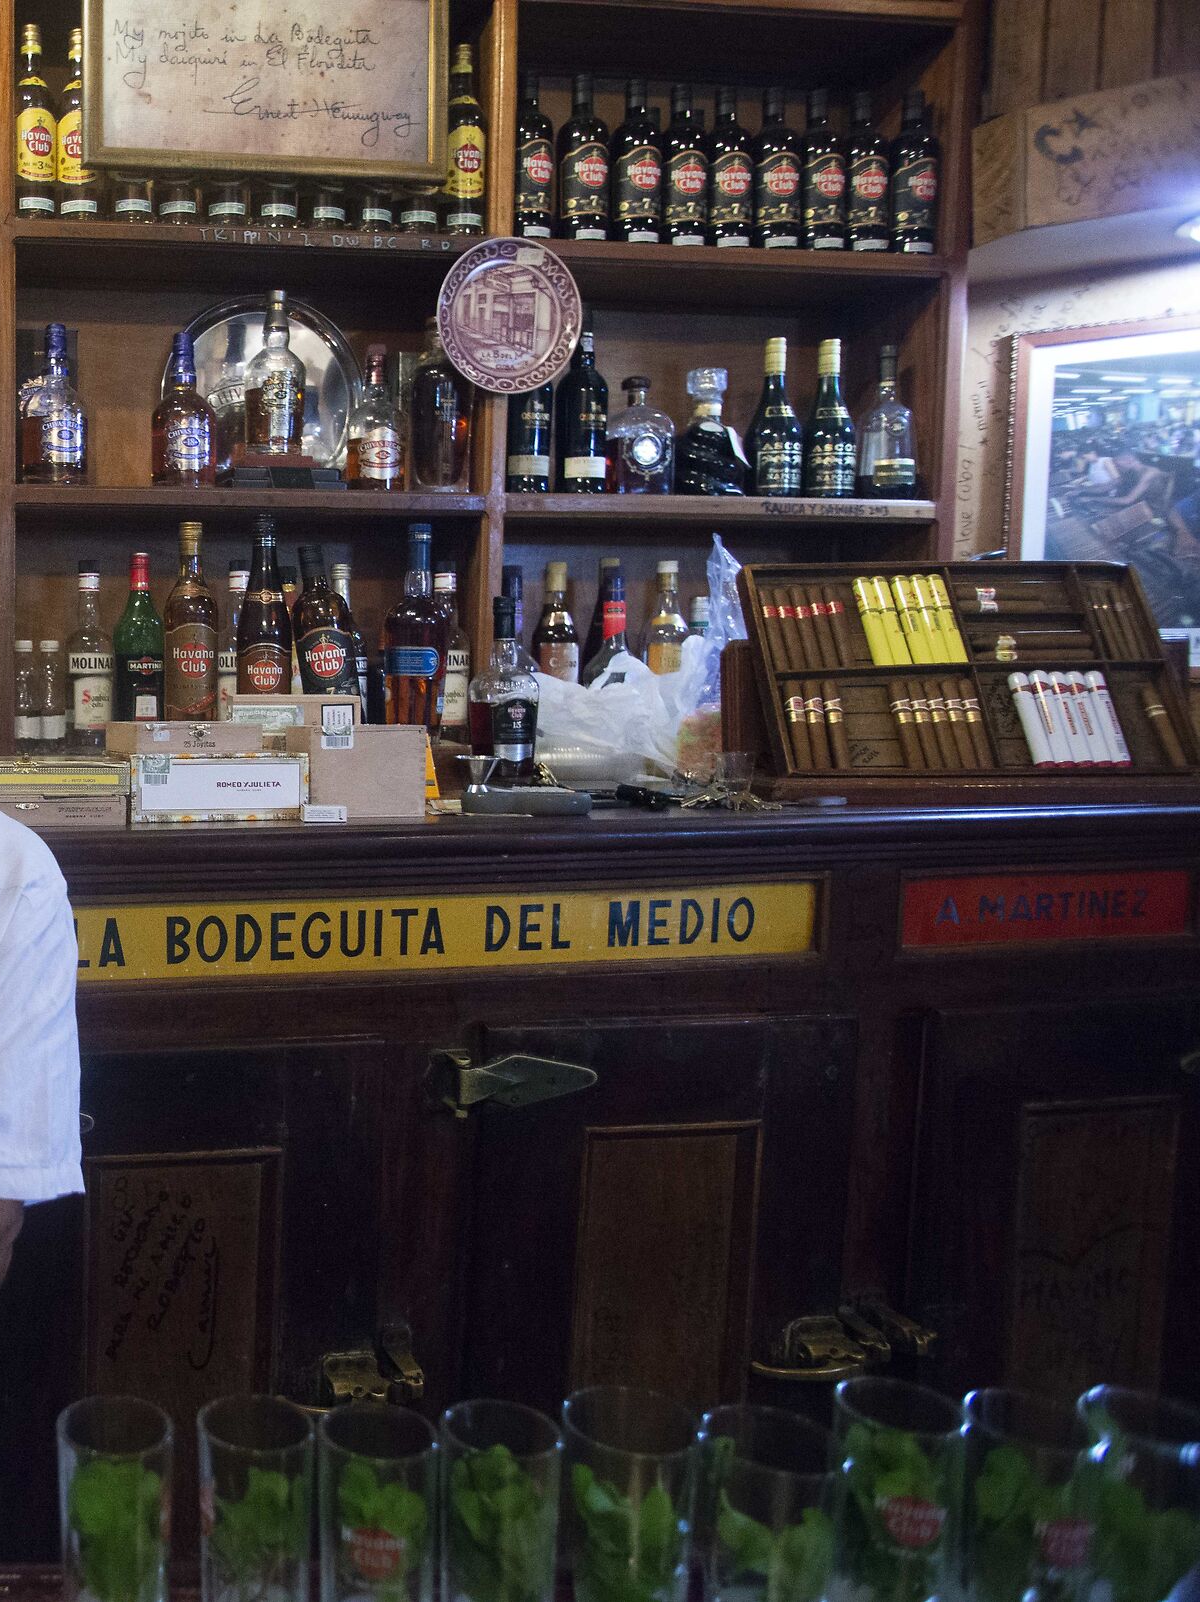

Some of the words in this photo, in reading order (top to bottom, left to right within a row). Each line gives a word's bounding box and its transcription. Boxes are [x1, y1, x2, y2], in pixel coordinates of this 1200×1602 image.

[113, 19, 145, 49] My
[158, 23, 209, 51] mojito
[220, 27, 247, 43] in
[255, 22, 283, 44] La
[291, 23, 379, 46] Bodeguita
[114, 42, 147, 89] My
[240, 55, 256, 68] in
[310, 99, 420, 147] Hemingway
[28, 140, 49, 152] Club
[208, 387, 243, 408] CHIV
[359, 441, 385, 452] CHIVAS
[173, 647, 214, 660] Havana
[305, 647, 347, 664] Havana
[129, 662, 162, 670] MARTINI
[181, 660, 207, 673] Club
[247, 665, 283, 676] Havana
[314, 659, 340, 673] Club
[253, 675, 276, 686] Club
[513, 720, 522, 729] 15
[978, 888, 1148, 925] MARTINEZ
[75, 916, 126, 968] LA
[165, 907, 445, 965] BODEGUITA
[484, 903, 571, 952] DEL
[607, 896, 755, 948] MEDIO
